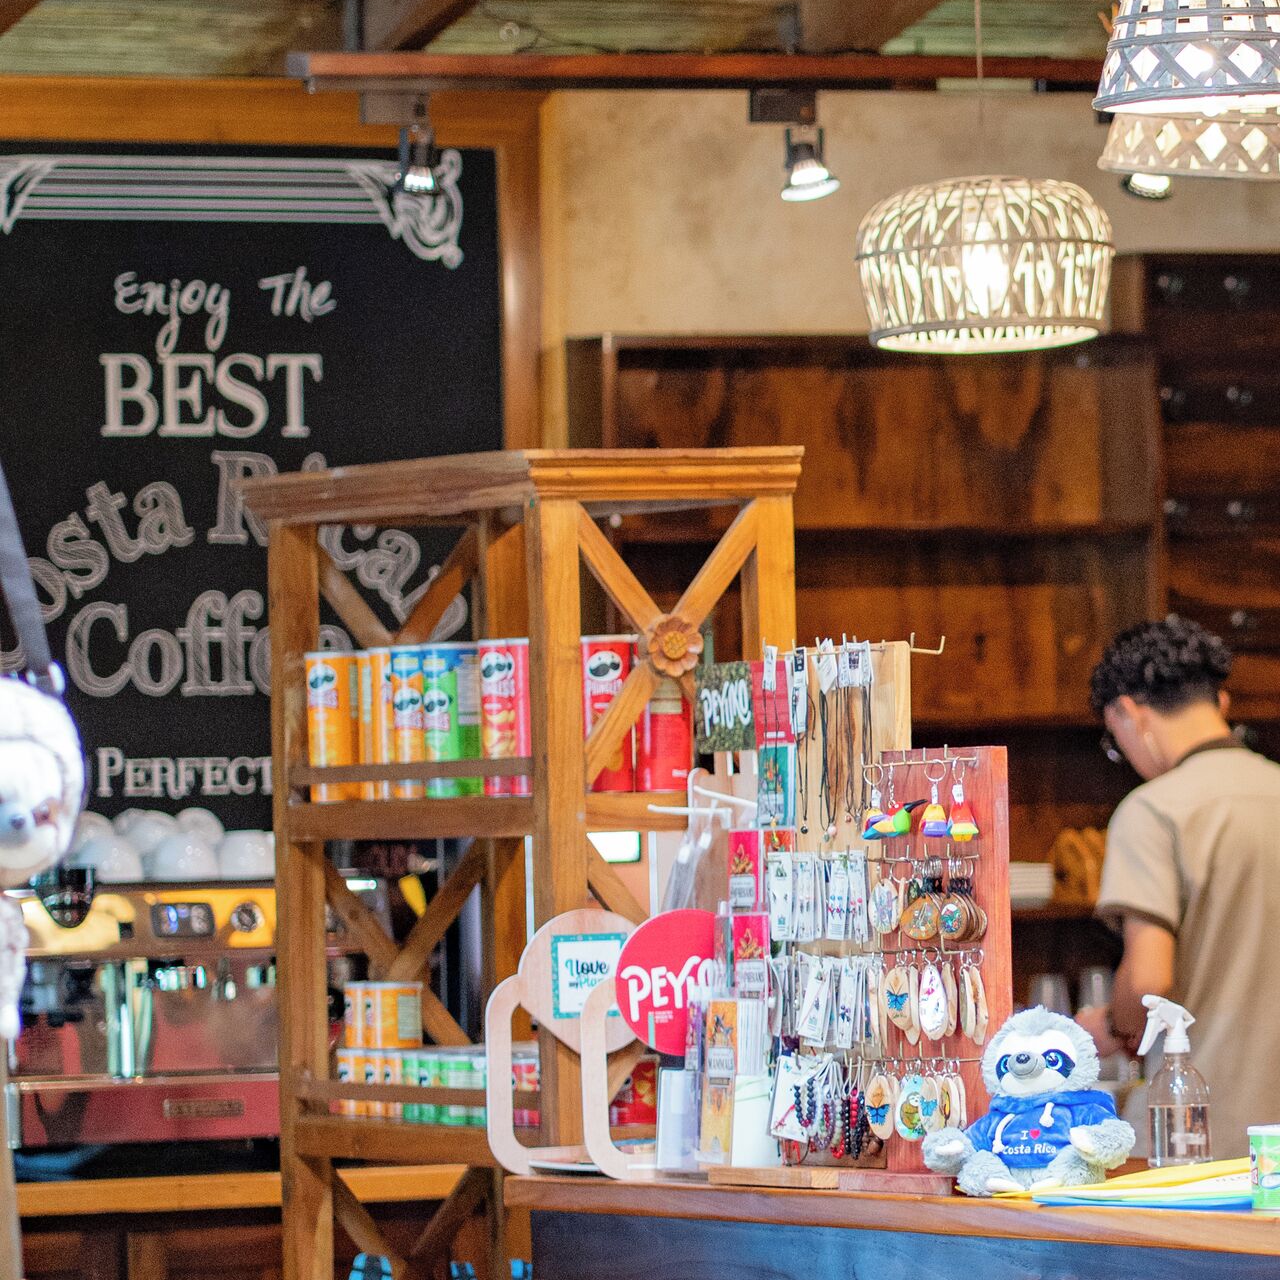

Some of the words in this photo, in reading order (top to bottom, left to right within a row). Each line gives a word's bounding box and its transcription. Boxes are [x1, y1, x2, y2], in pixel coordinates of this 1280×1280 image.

[113, 271, 231, 360] Enjoy
[258, 266, 337, 322] The
[99, 352, 323, 438] BEST
[0, 480, 195, 672] osta
[65, 589, 353, 698] Coff
[575, 959, 610, 975] love
[1002, 1143, 1031, 1155] Costa
[1033, 1142, 1057, 1154] Rica
